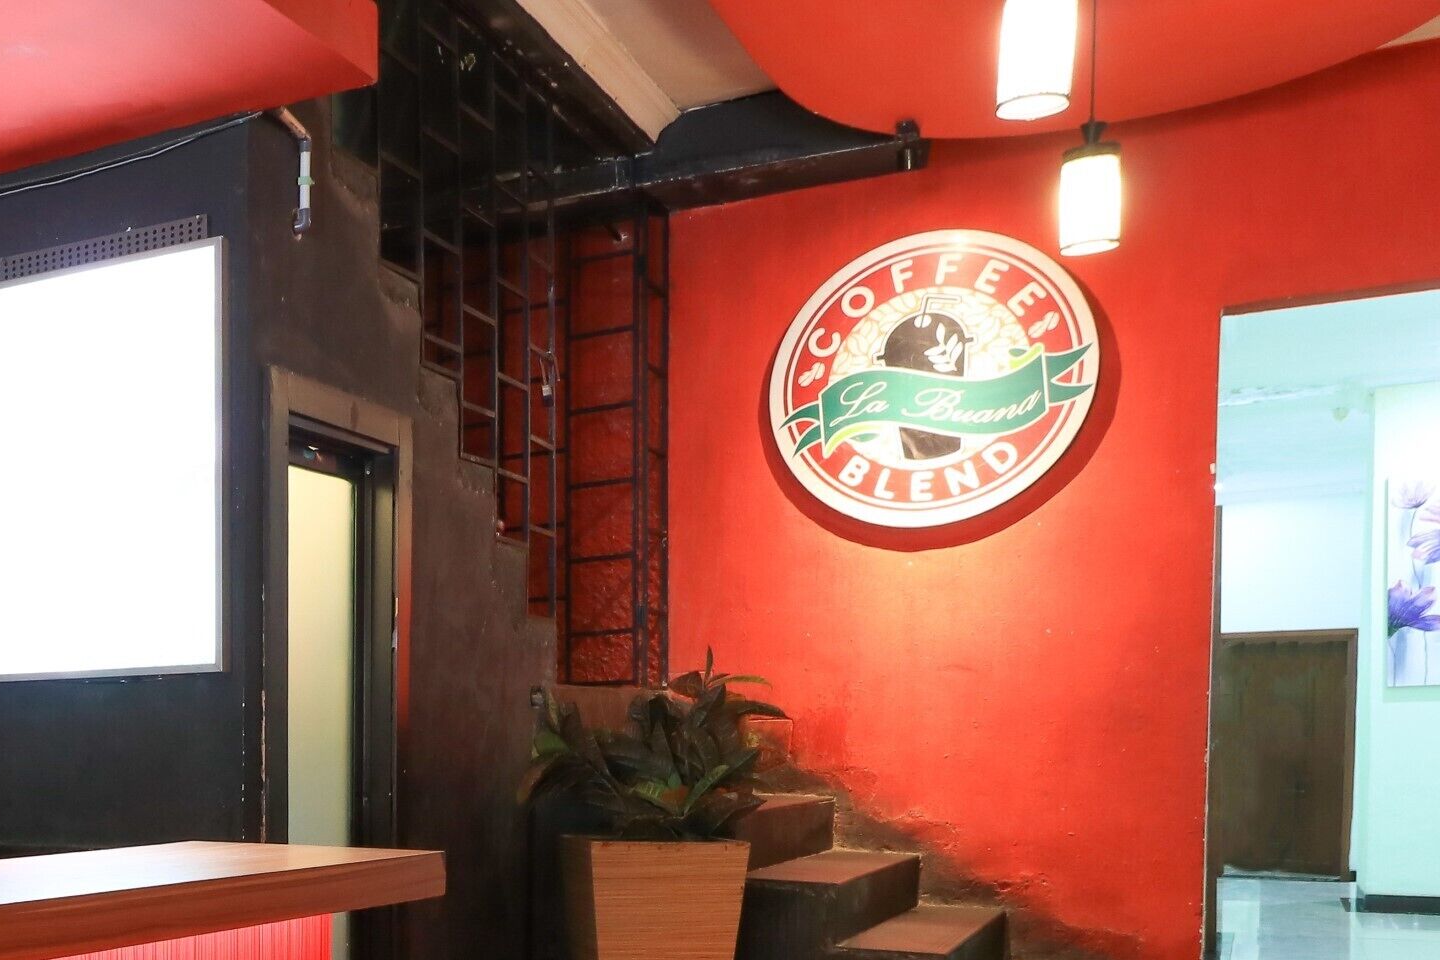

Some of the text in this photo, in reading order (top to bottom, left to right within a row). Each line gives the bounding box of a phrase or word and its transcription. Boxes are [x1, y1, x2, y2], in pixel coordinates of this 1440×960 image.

[808, 253, 1047, 358] COFFEE
[829, 381, 889, 427] La
[837, 441, 1019, 502] BLEND
